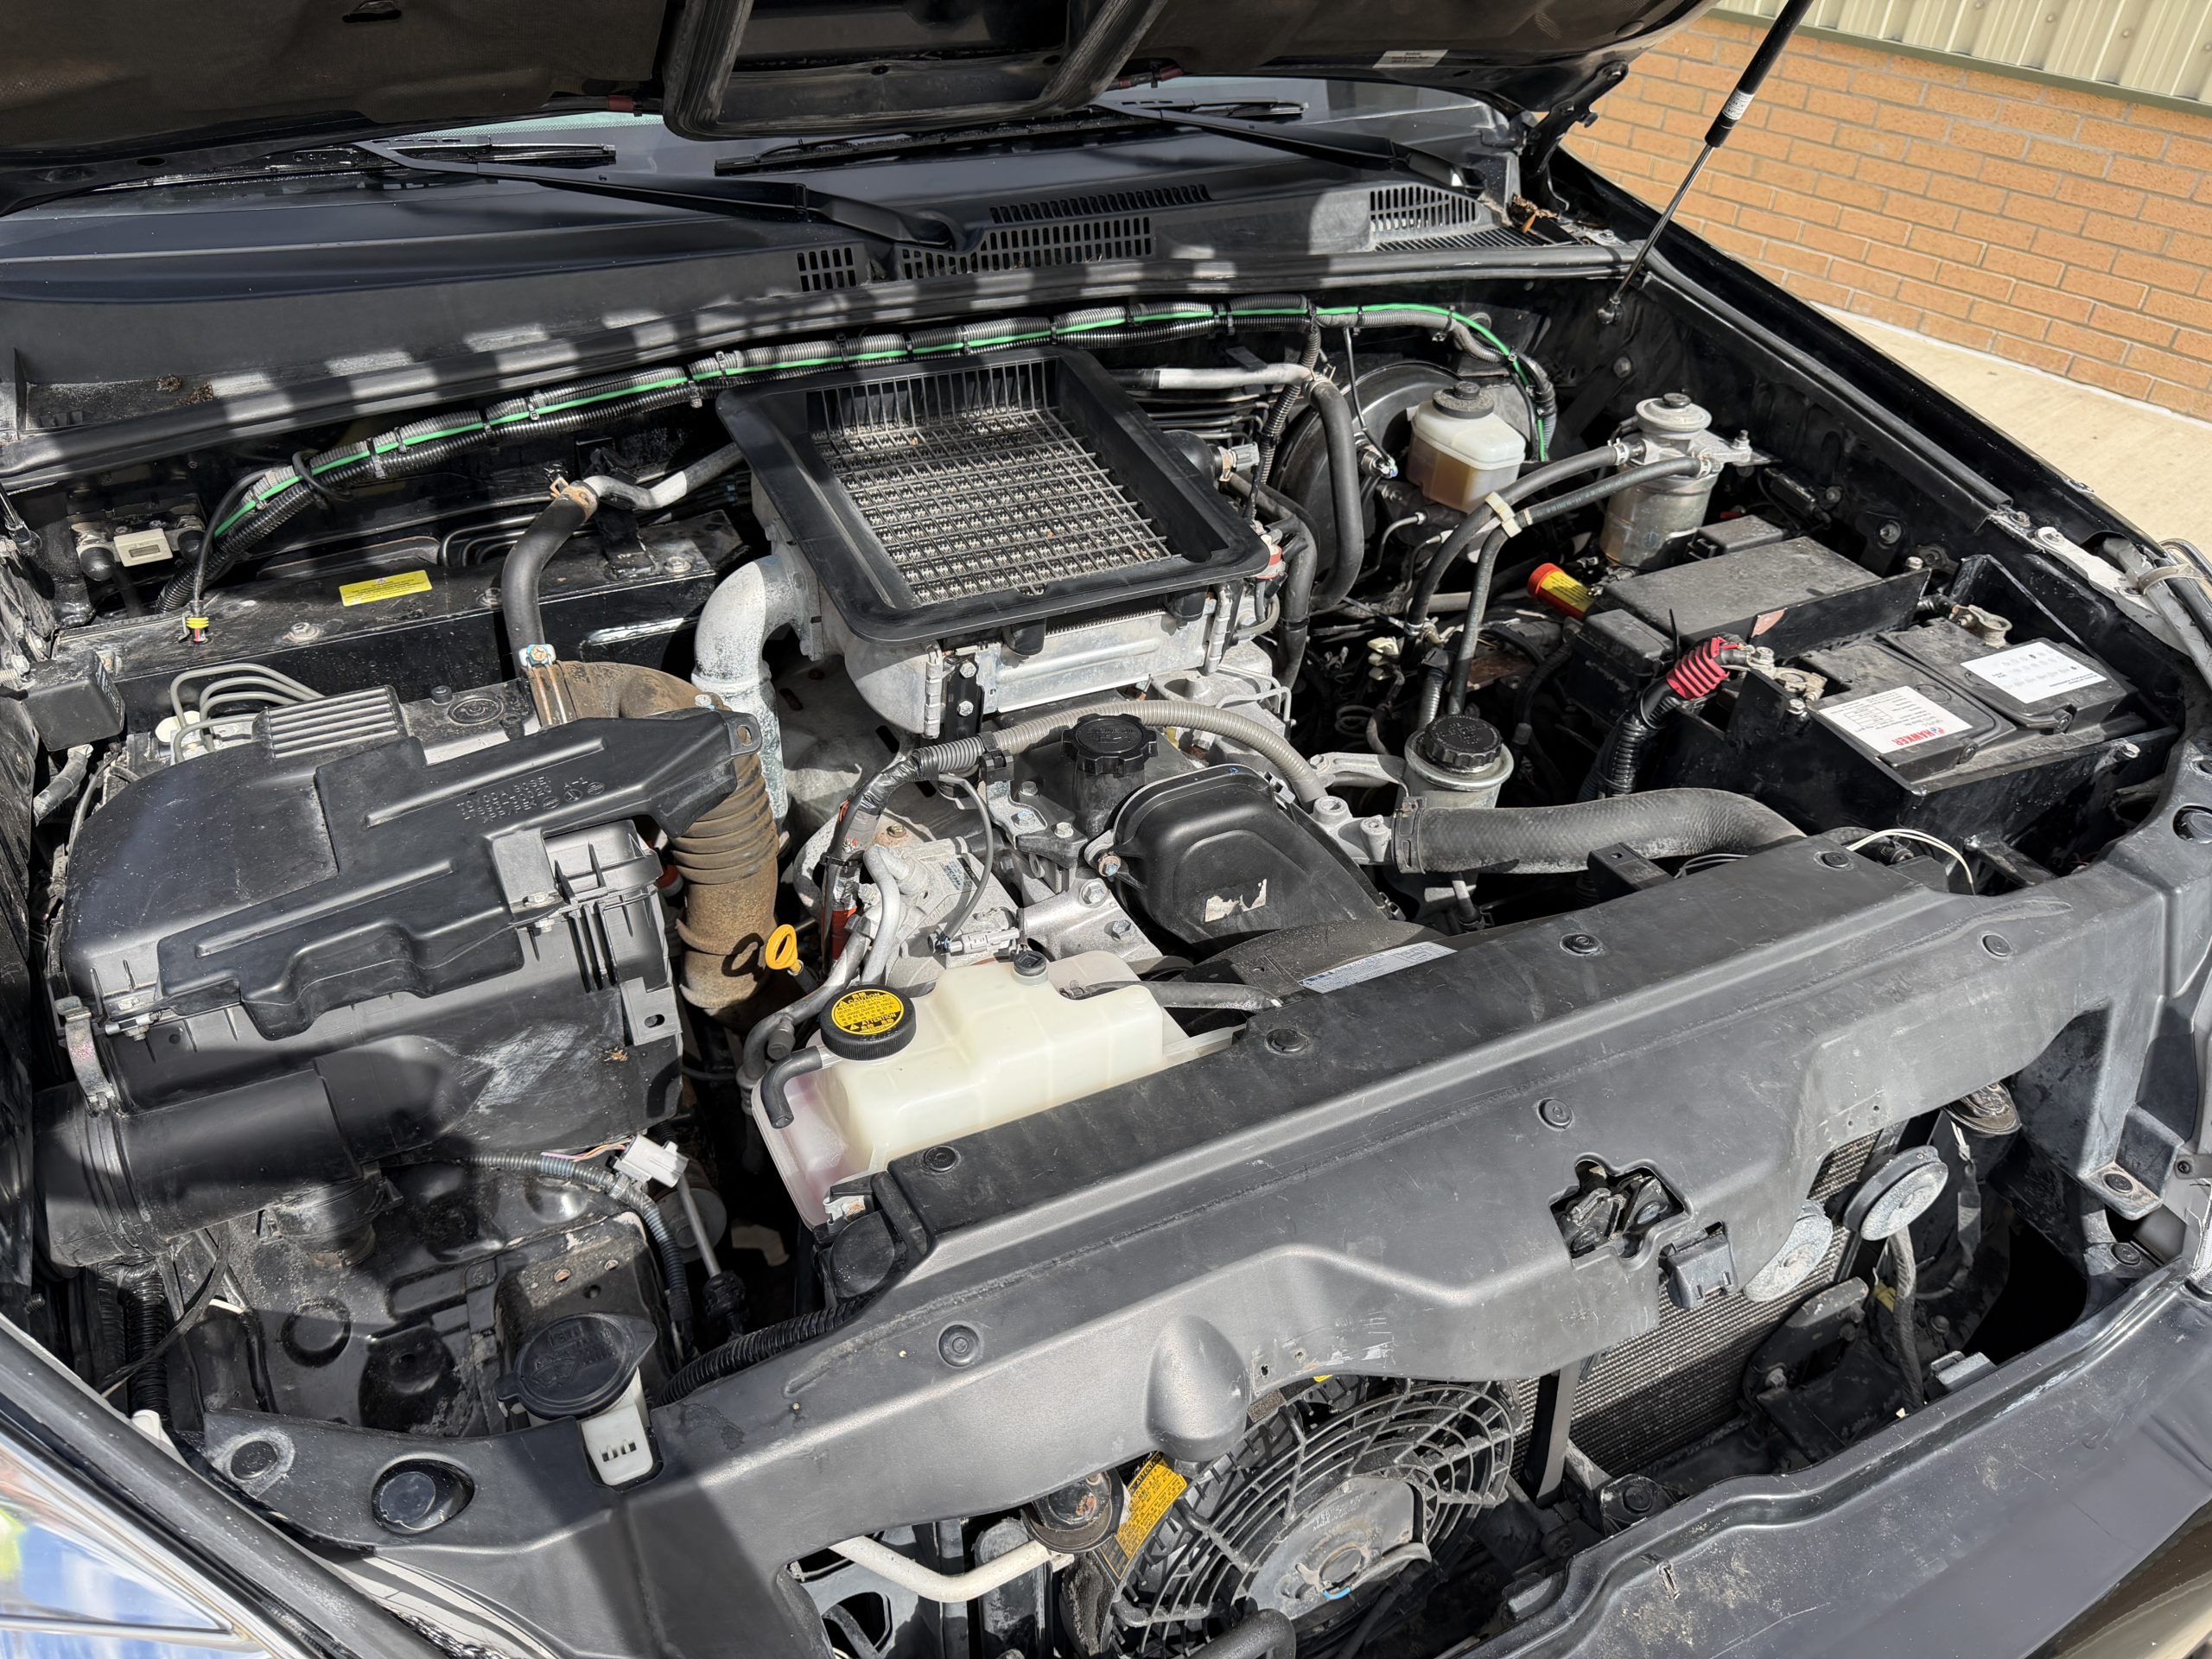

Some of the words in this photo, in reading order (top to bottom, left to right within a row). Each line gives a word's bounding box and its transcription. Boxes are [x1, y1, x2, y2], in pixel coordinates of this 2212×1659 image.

[1891, 729, 1936, 746] HAWKER
[848, 993, 880, 1004] CAUTION
[861, 1013, 896, 1026] ATTENTION
[1136, 1454, 1161, 1484] ATTENTION
